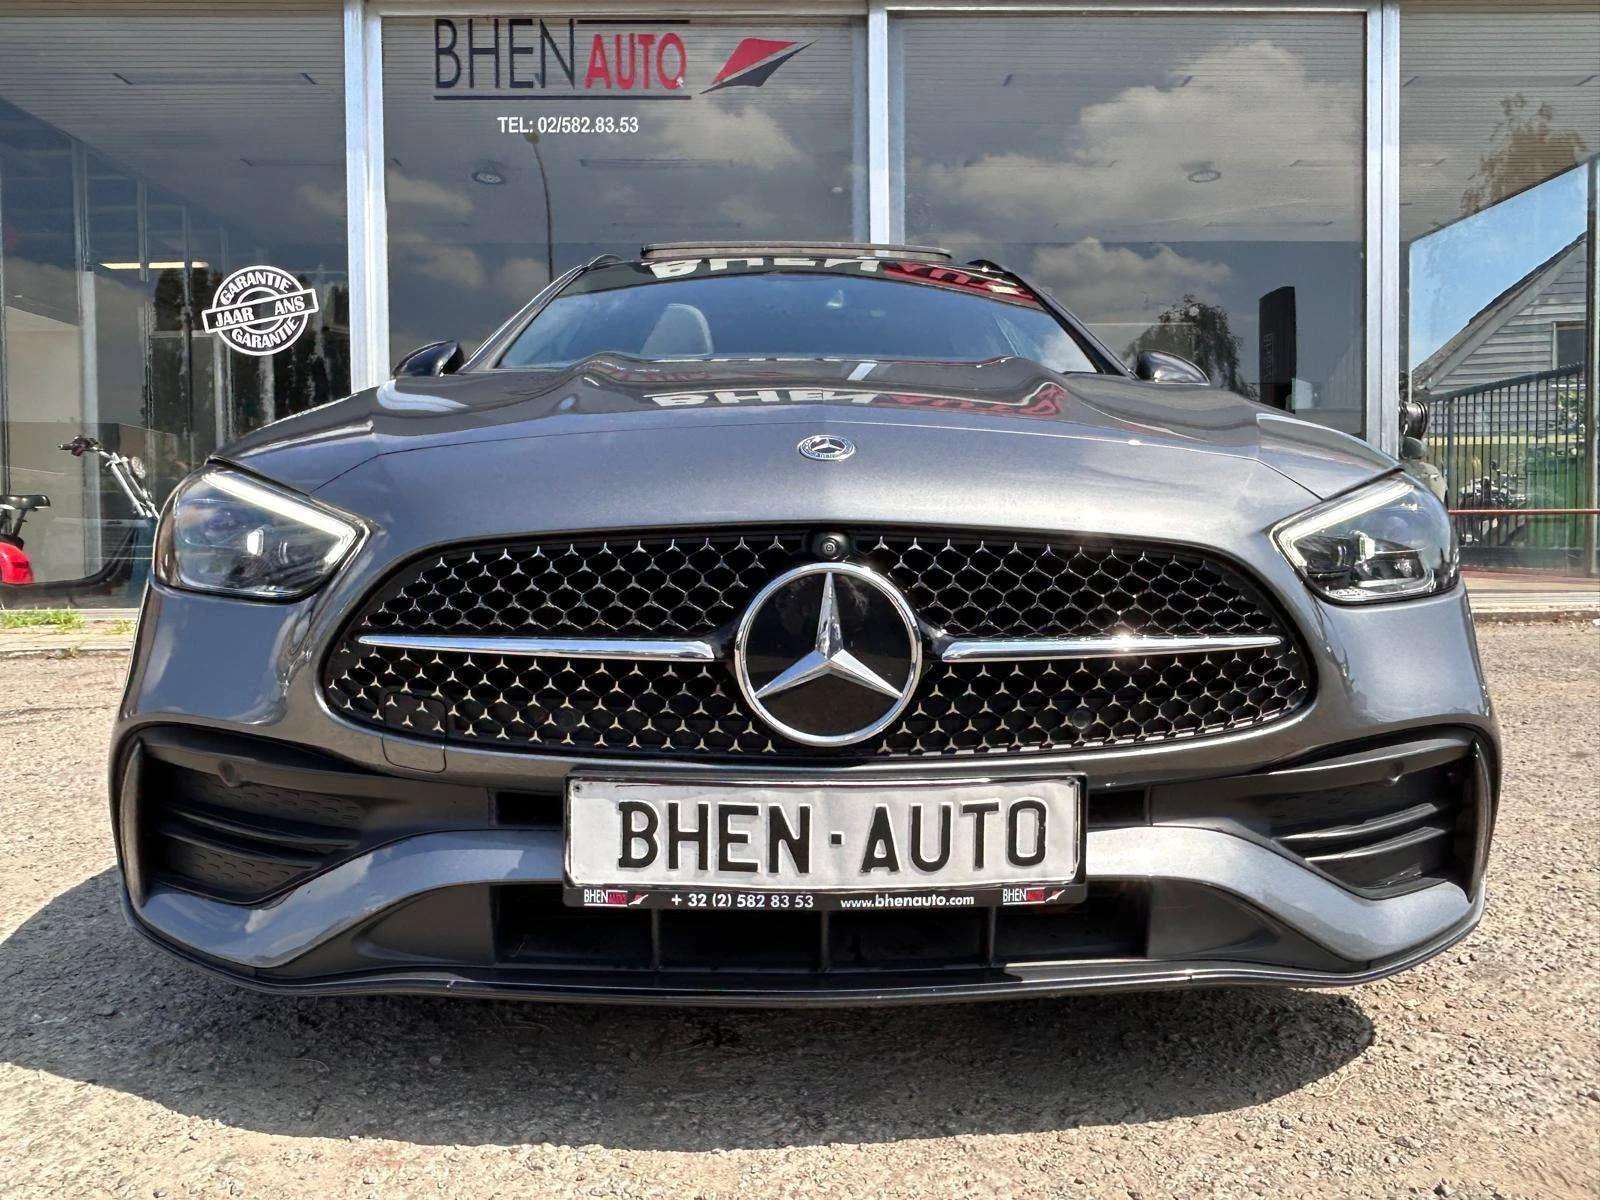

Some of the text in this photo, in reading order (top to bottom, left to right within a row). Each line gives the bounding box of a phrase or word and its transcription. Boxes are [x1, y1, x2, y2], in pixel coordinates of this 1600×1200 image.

[497, 115, 639, 135] TEL: 02/582.83.53
[220, 271, 291, 305] GARANTIE
[215, 296, 306, 327] JAAR ANS
[231, 318, 299, 348] GARANTIE
[584, 888, 608, 904] BHEN
[688, 893, 707, 908] 32
[712, 893, 732, 909] (2)
[737, 894, 765, 908] 582
[771, 894, 790, 908] 83
[795, 895, 814, 908] 53
[840, 894, 975, 908] www.bhenauto.com
[1003, 888, 1026, 902] BHEN
